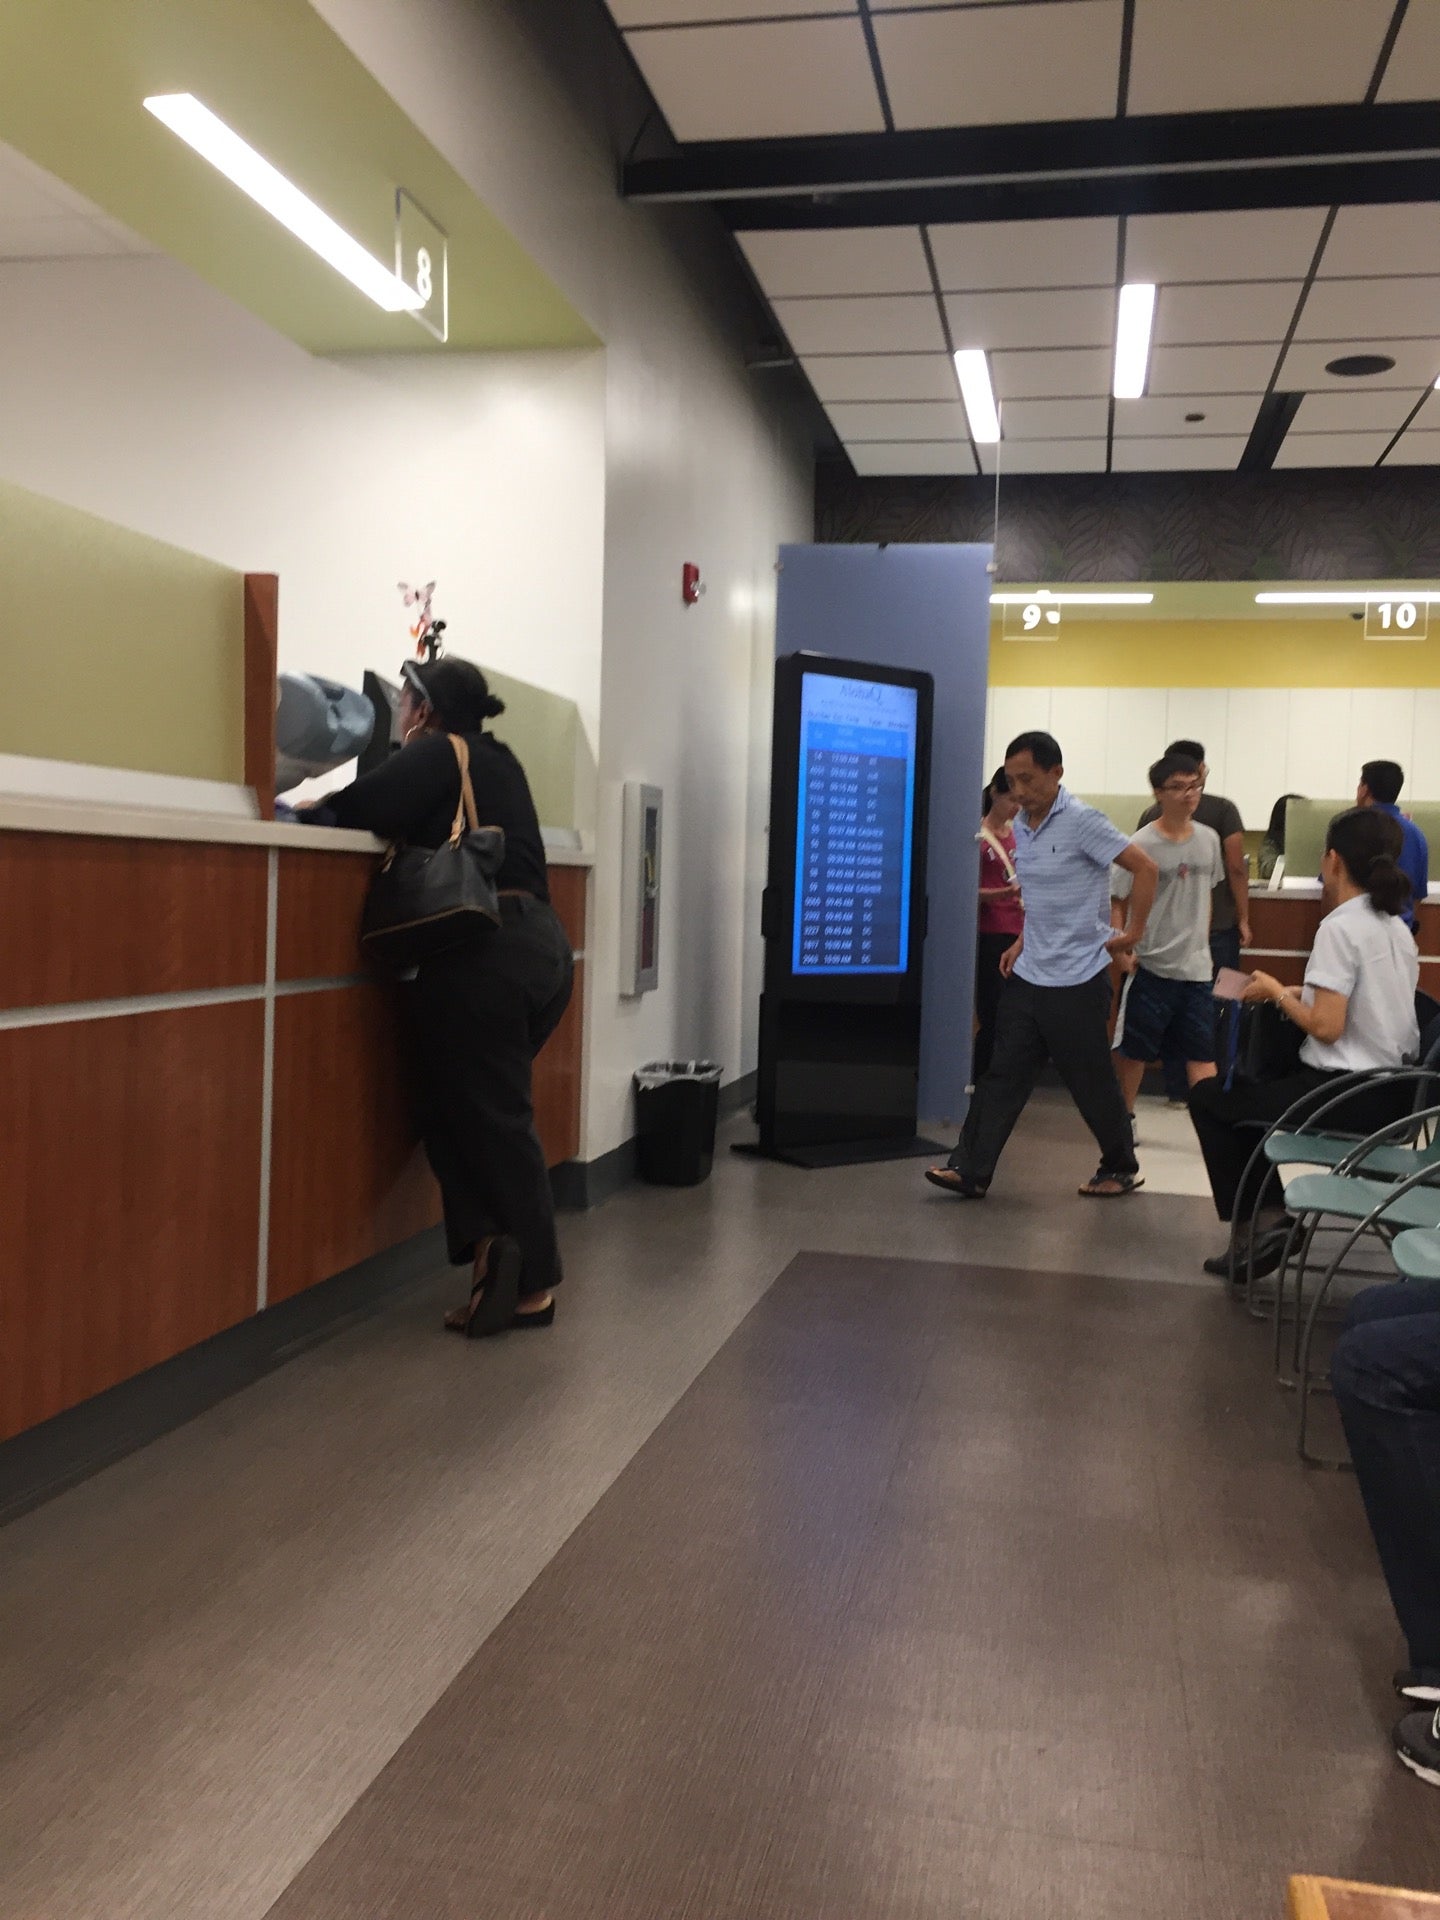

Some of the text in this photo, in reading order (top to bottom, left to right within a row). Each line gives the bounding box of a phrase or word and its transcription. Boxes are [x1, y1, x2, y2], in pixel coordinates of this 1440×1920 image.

[416, 247, 432, 301] 8
[1022, 604, 1041, 630] 9
[1378, 602, 1417, 629] 10
